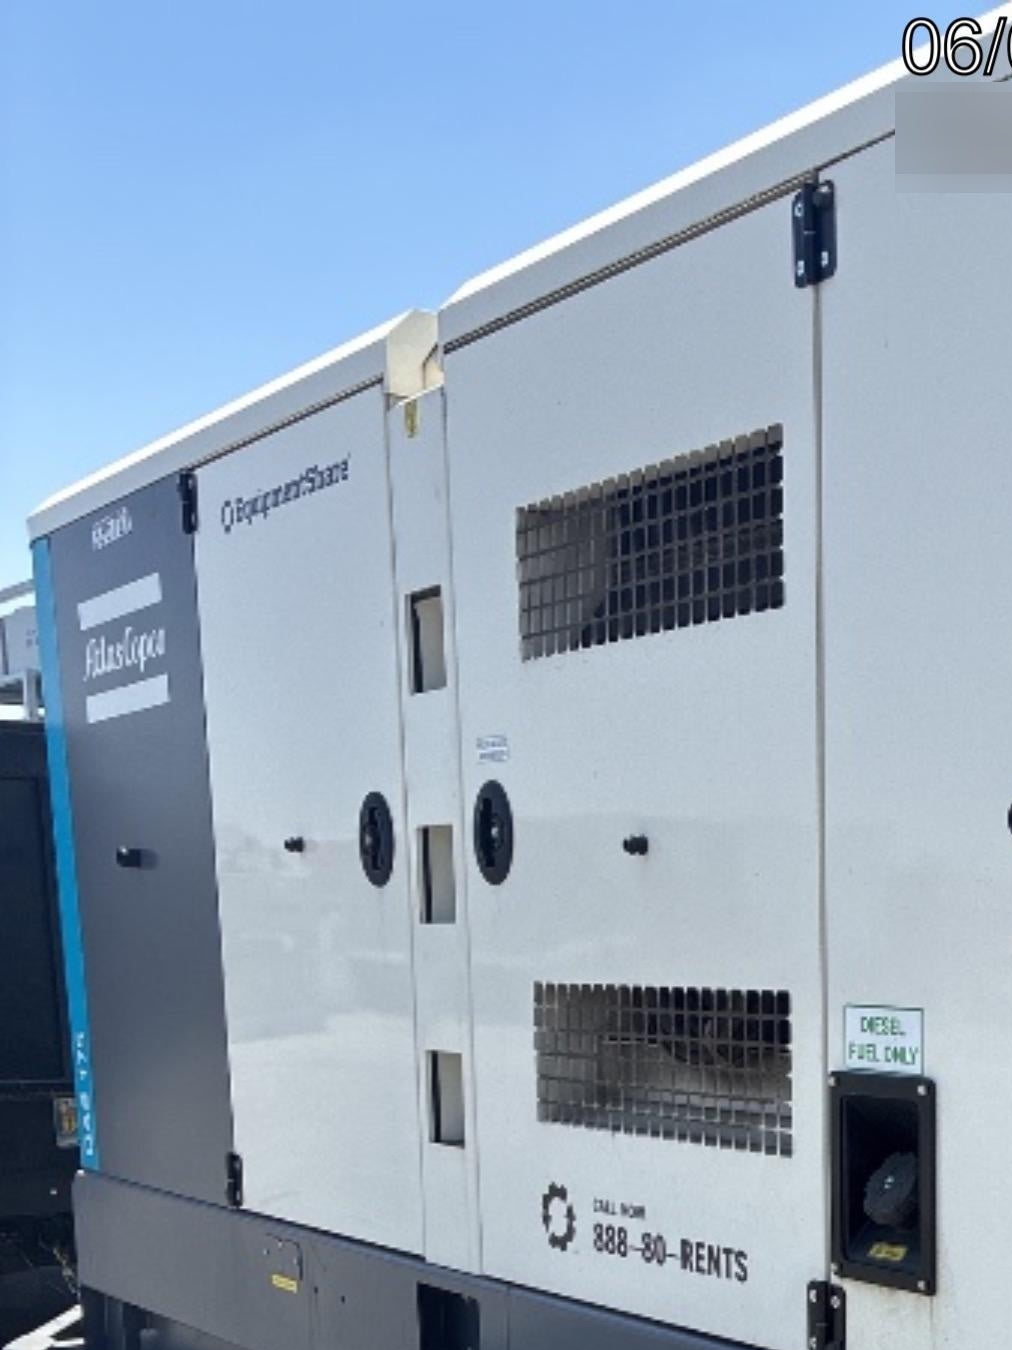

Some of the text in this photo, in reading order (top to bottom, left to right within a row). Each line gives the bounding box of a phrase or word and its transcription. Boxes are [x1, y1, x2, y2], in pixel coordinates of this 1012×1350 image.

[236, 460, 349, 526] EquipmentShare
[860, 1016, 907, 1037] DIESEL
[848, 1043, 919, 1066] FUEL ONLY
[593, 1222, 749, 1284] 888-80-RENTS
